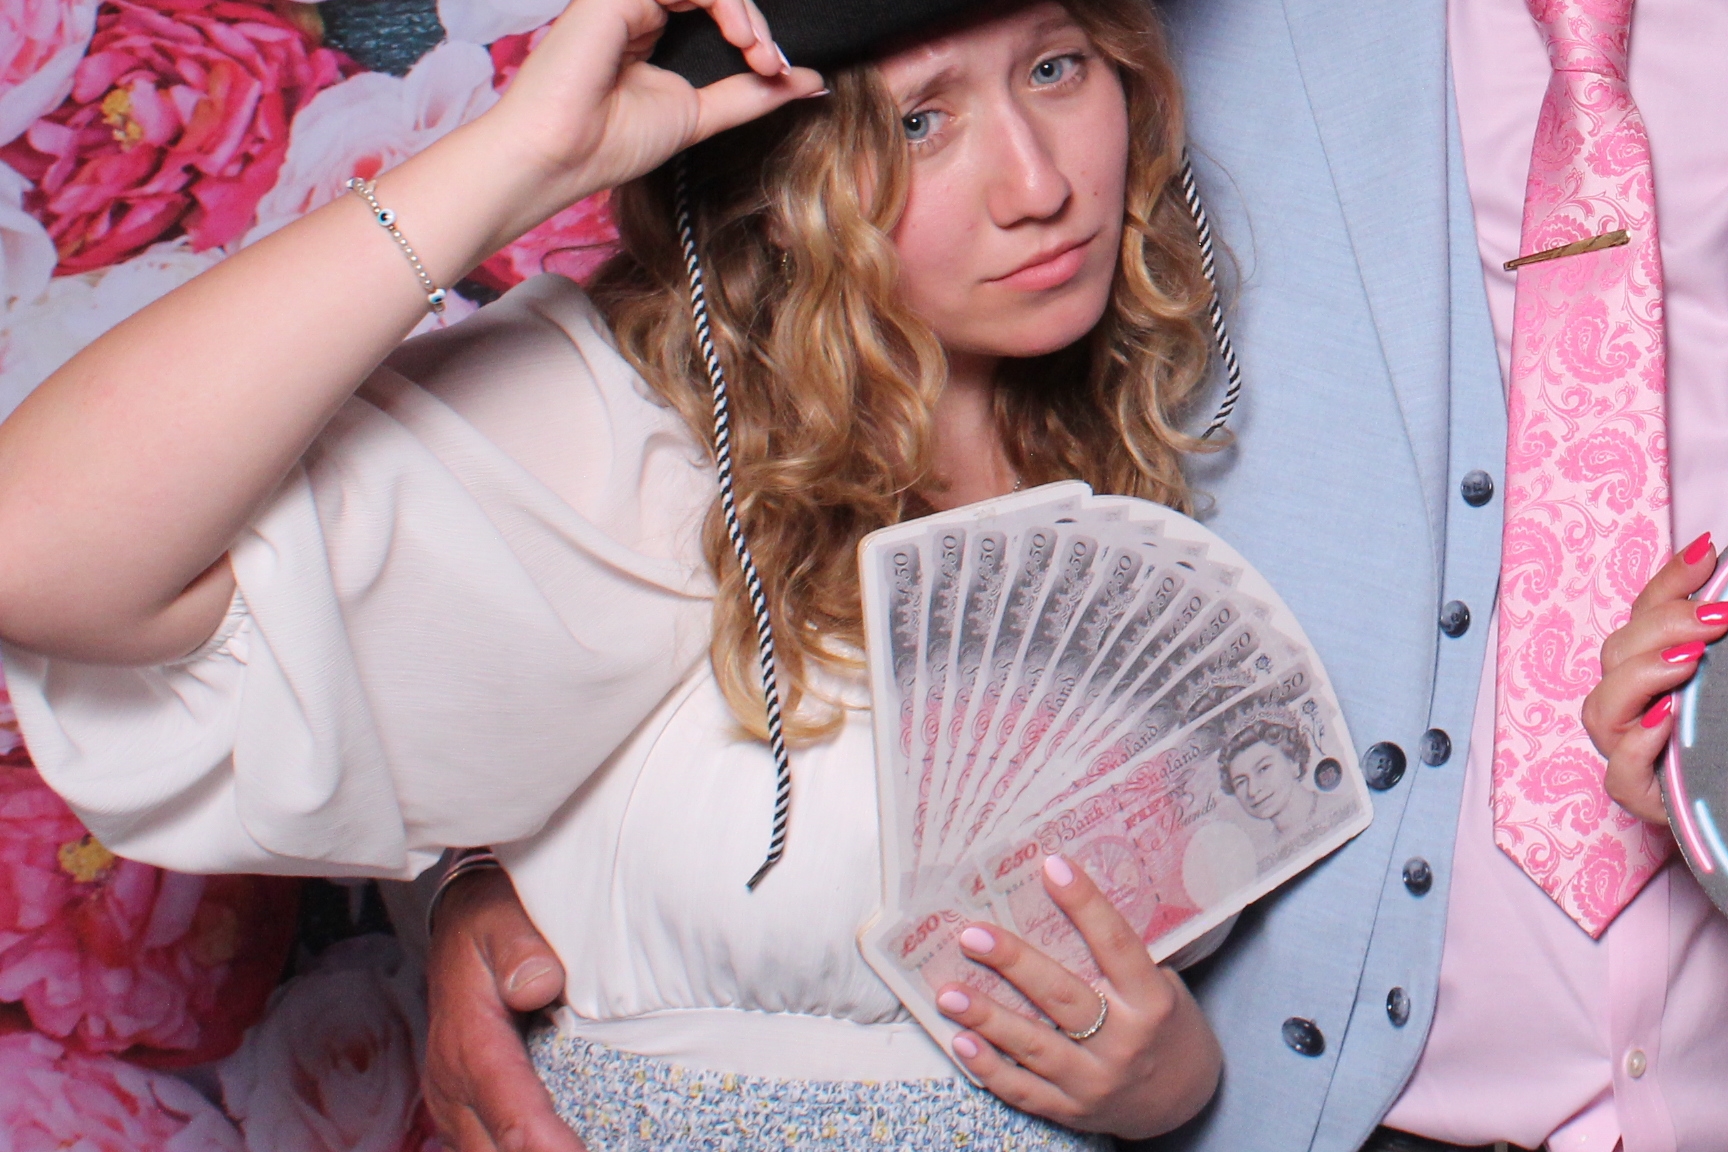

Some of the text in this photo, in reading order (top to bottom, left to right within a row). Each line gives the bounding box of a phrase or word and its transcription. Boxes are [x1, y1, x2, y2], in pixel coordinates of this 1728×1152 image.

[1125, 741, 1201, 786] England
[995, 842, 1038, 880] £50
[902, 914, 940, 958] £50
